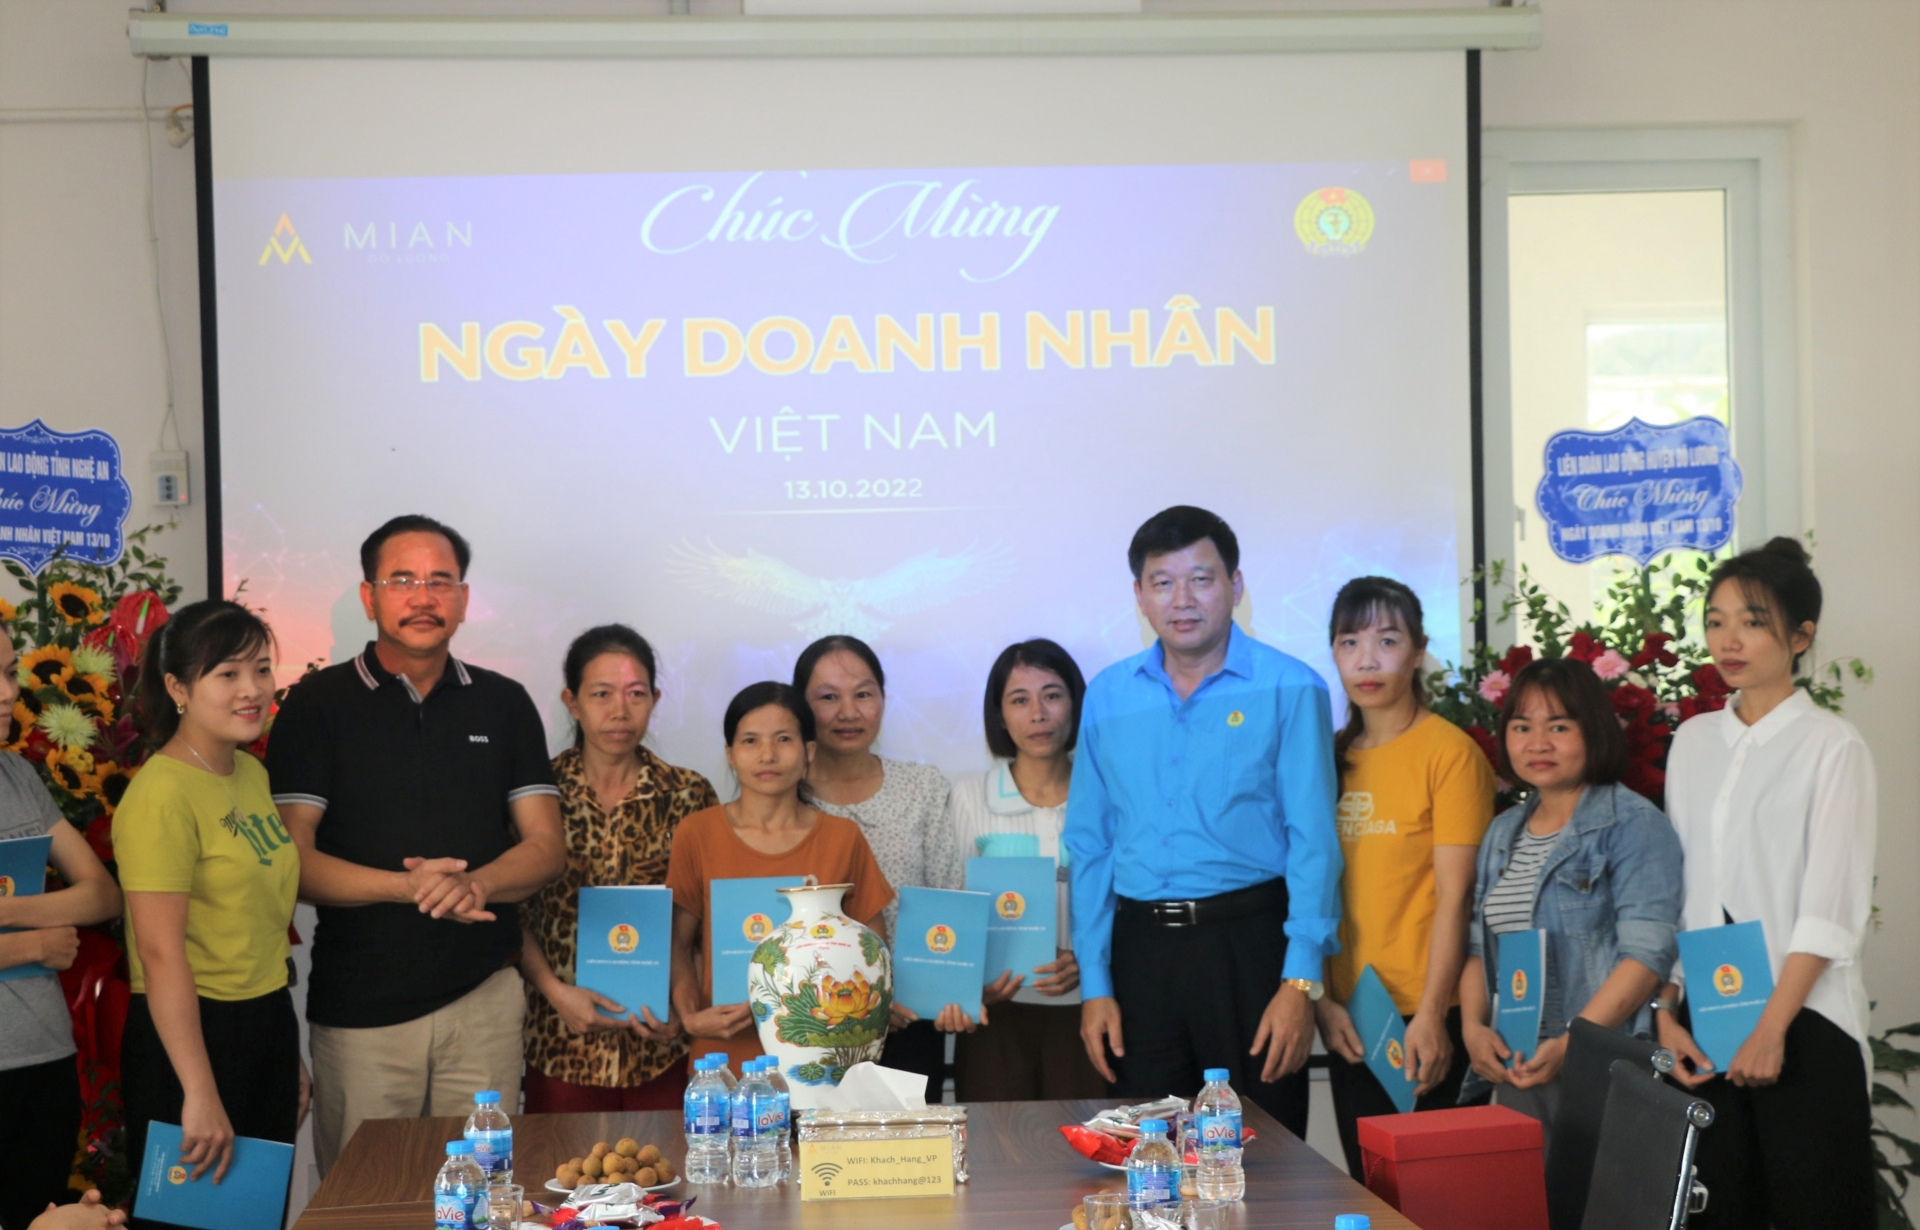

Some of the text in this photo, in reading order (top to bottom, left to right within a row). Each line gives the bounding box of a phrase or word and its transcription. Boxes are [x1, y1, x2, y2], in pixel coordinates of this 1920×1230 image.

[344, 221, 472, 249] MIAN
[641, 171, 1060, 283] Chúc Mừng
[419, 294, 1275, 382] NGÀY DOANH NHÂN
[709, 405, 995, 462] VIỆT NAM
[7, 452, 23, 473] LAO
[25, 450, 49, 479] ĐỘNG
[51, 450, 70, 477] TỈNH
[72, 456, 95, 483] NGHỆ
[97, 461, 109, 480] AN
[784, 478, 923, 500] 13.10.2022
[1576, 484, 1628, 512] Chúc
[30, 485, 102, 528] Mừng
[15, 525, 40, 543] NHÂN
[42, 527, 61, 547] VIỆT
[63, 530, 84, 546] NAM
[86, 533, 110, 548] 13/10
[847, 1155, 938, 1165] WIFI: Khach_Hang_VP
[847, 1176, 941, 1186] PASS: khachhang@123
